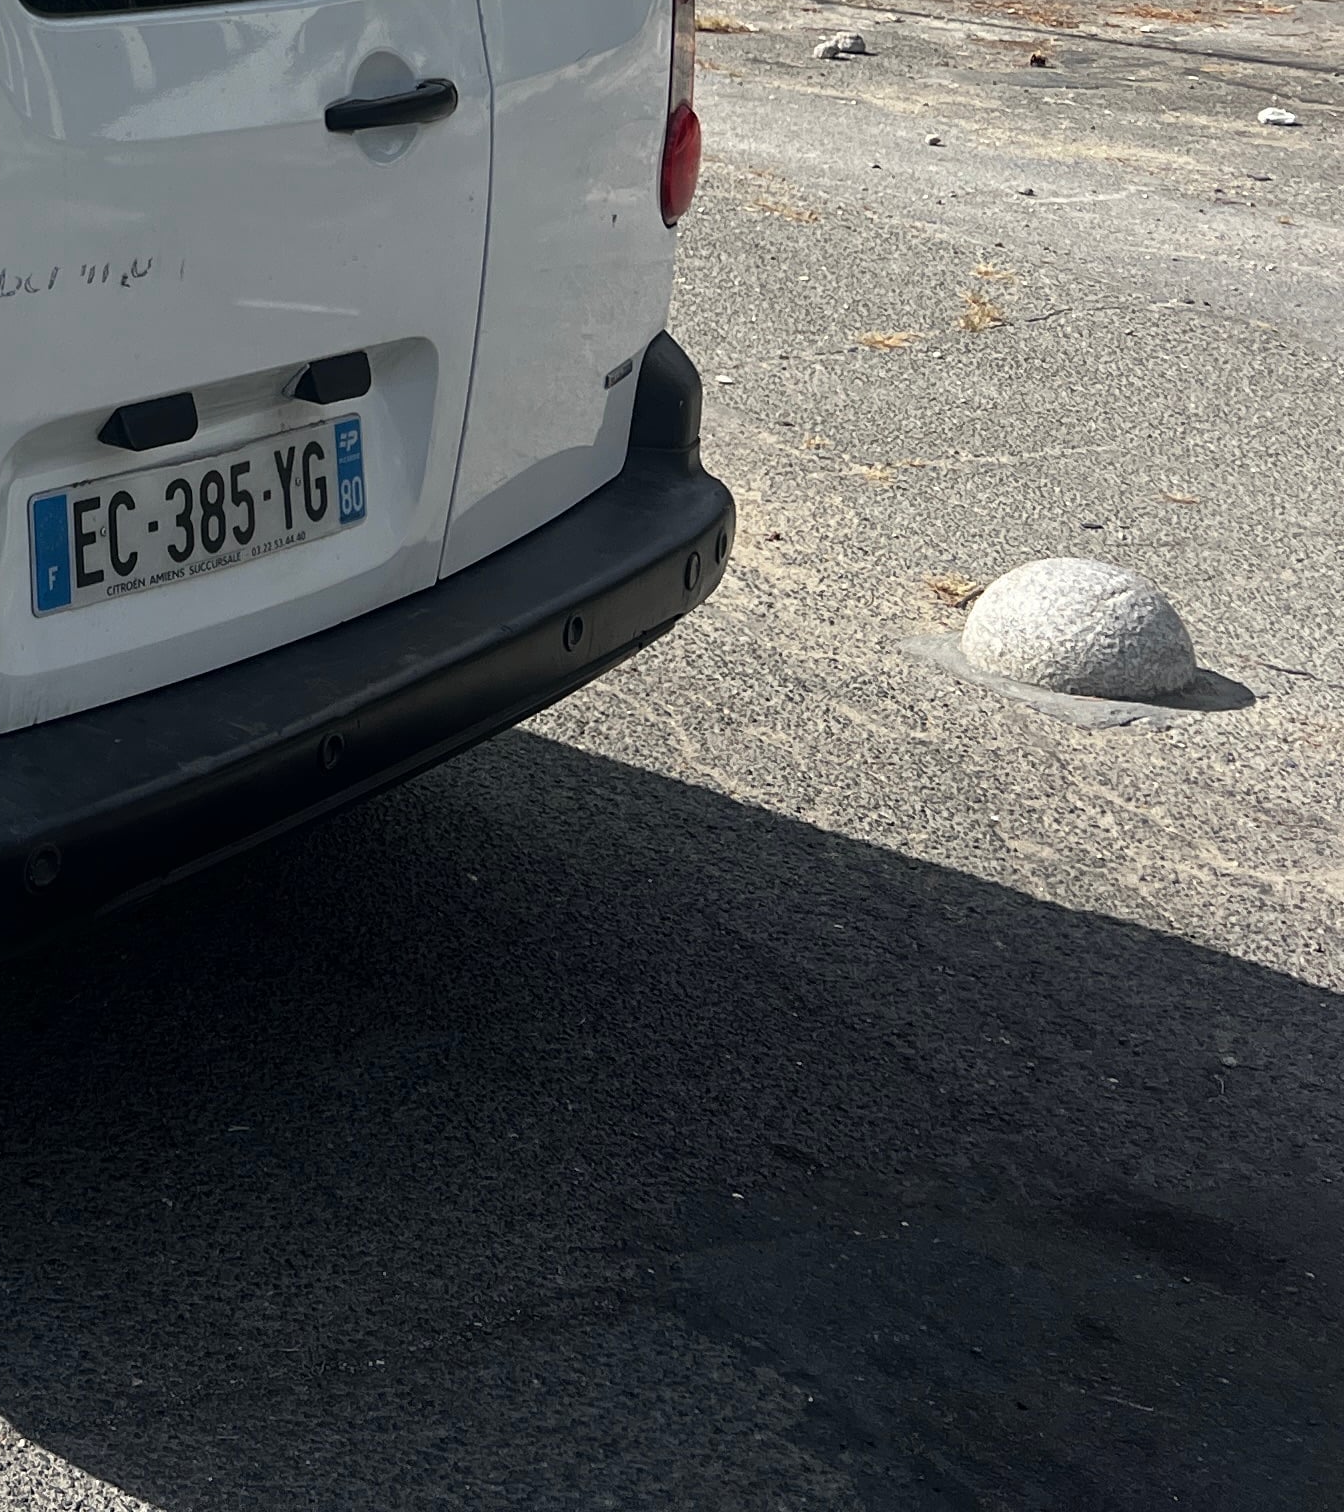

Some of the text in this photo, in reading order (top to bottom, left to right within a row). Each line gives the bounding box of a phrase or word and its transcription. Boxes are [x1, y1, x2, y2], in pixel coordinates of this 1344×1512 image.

[340, 476, 363, 515] 80
[73, 441, 327, 588] EC-385-YG
[47, 565, 59, 591] F
[149, 567, 186, 587] AMIENS
[189, 551, 242, 575] SUCCURSALE
